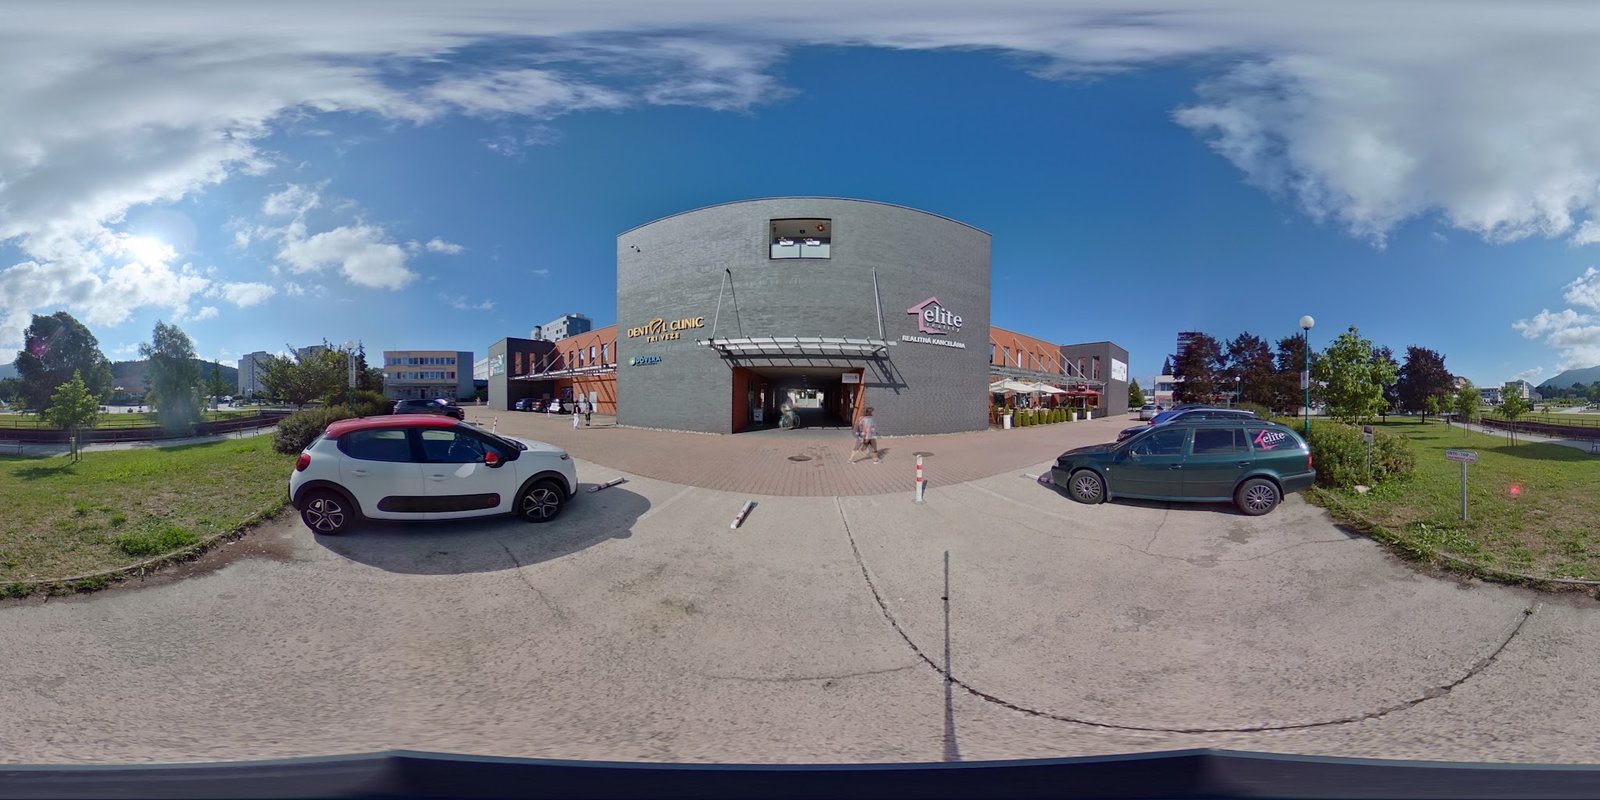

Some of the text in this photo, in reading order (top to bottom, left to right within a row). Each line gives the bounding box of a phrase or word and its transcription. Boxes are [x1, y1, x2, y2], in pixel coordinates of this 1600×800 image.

[670, 316, 704, 331] CLINIC
[924, 306, 963, 328] elite
[902, 335, 932, 344] REALITNÁ
[1262, 432, 1286, 443] elite
